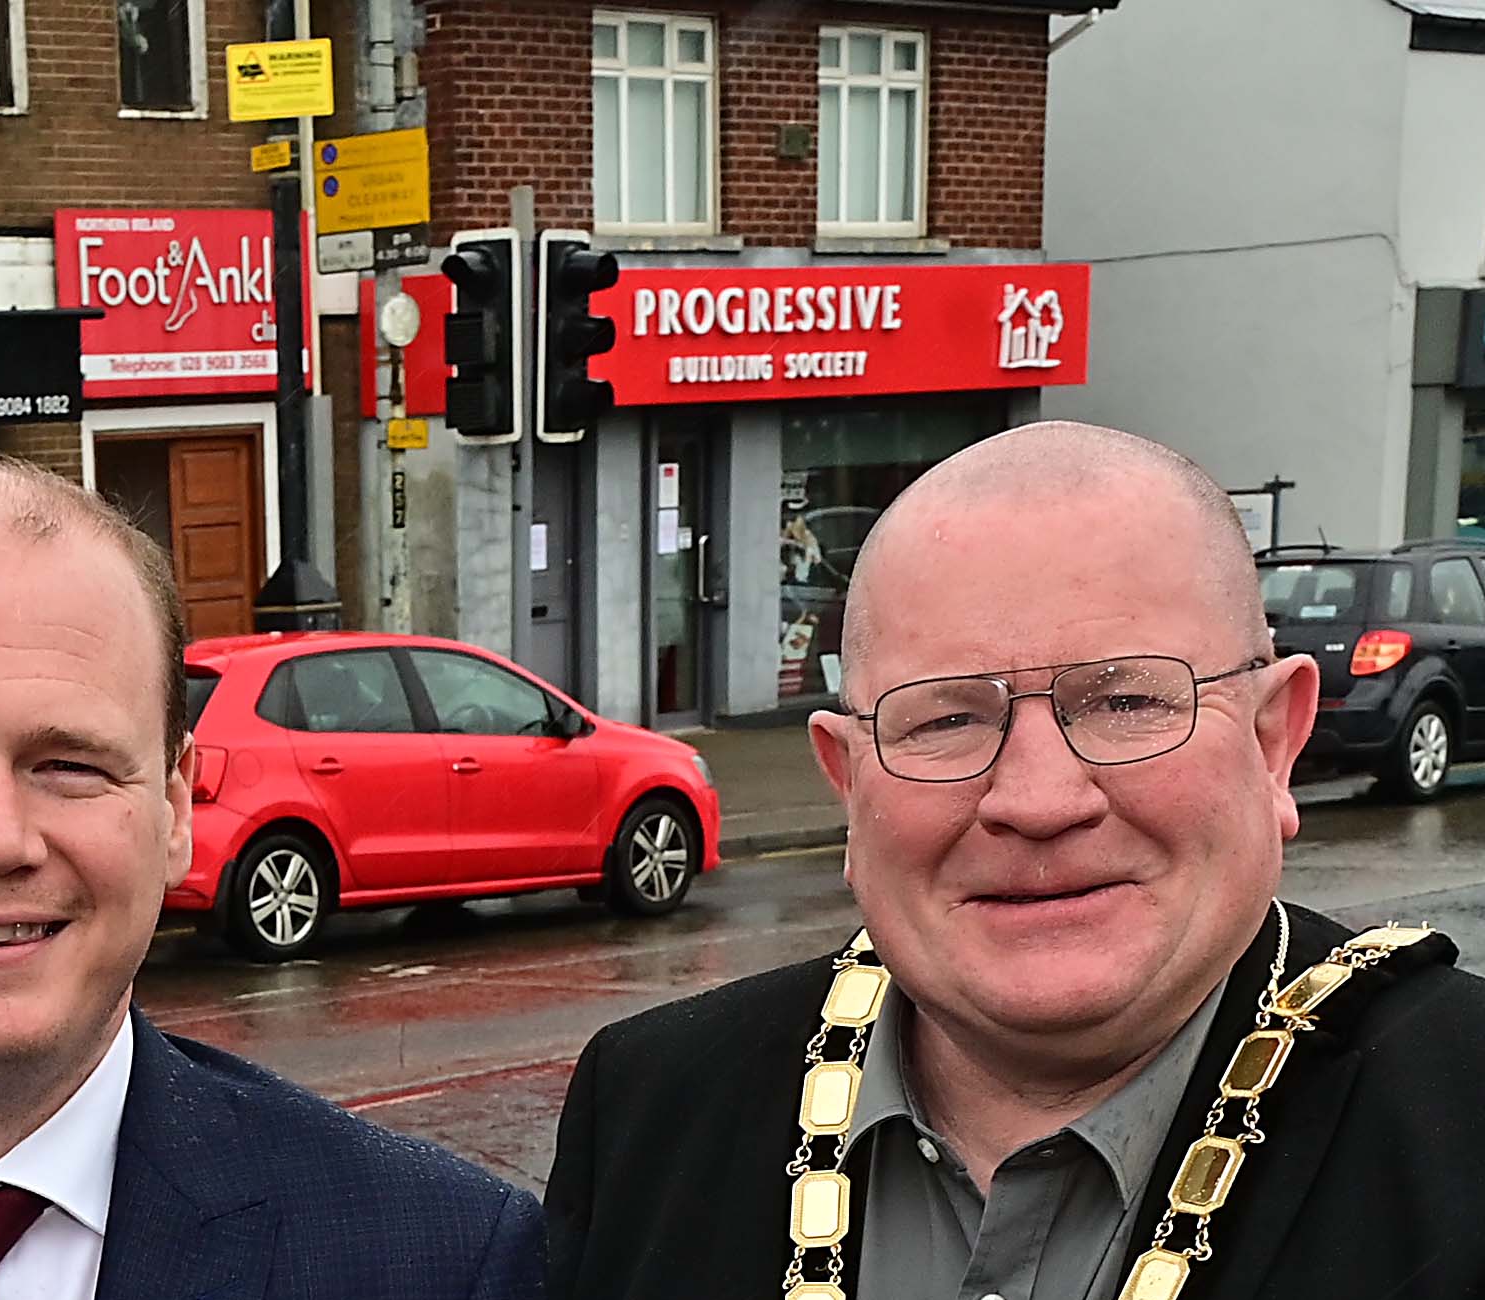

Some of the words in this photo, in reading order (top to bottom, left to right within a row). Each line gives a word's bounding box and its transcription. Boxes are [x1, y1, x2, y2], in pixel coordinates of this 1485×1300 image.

[78, 236, 172, 306] Foot
[175, 236, 273, 305] Ankl
[632, 285, 902, 336] PROGRESSIVE
[668, 354, 774, 384] BUILDING
[784, 351, 868, 379] SOCIETY
[35, 394, 70, 415] 1882
